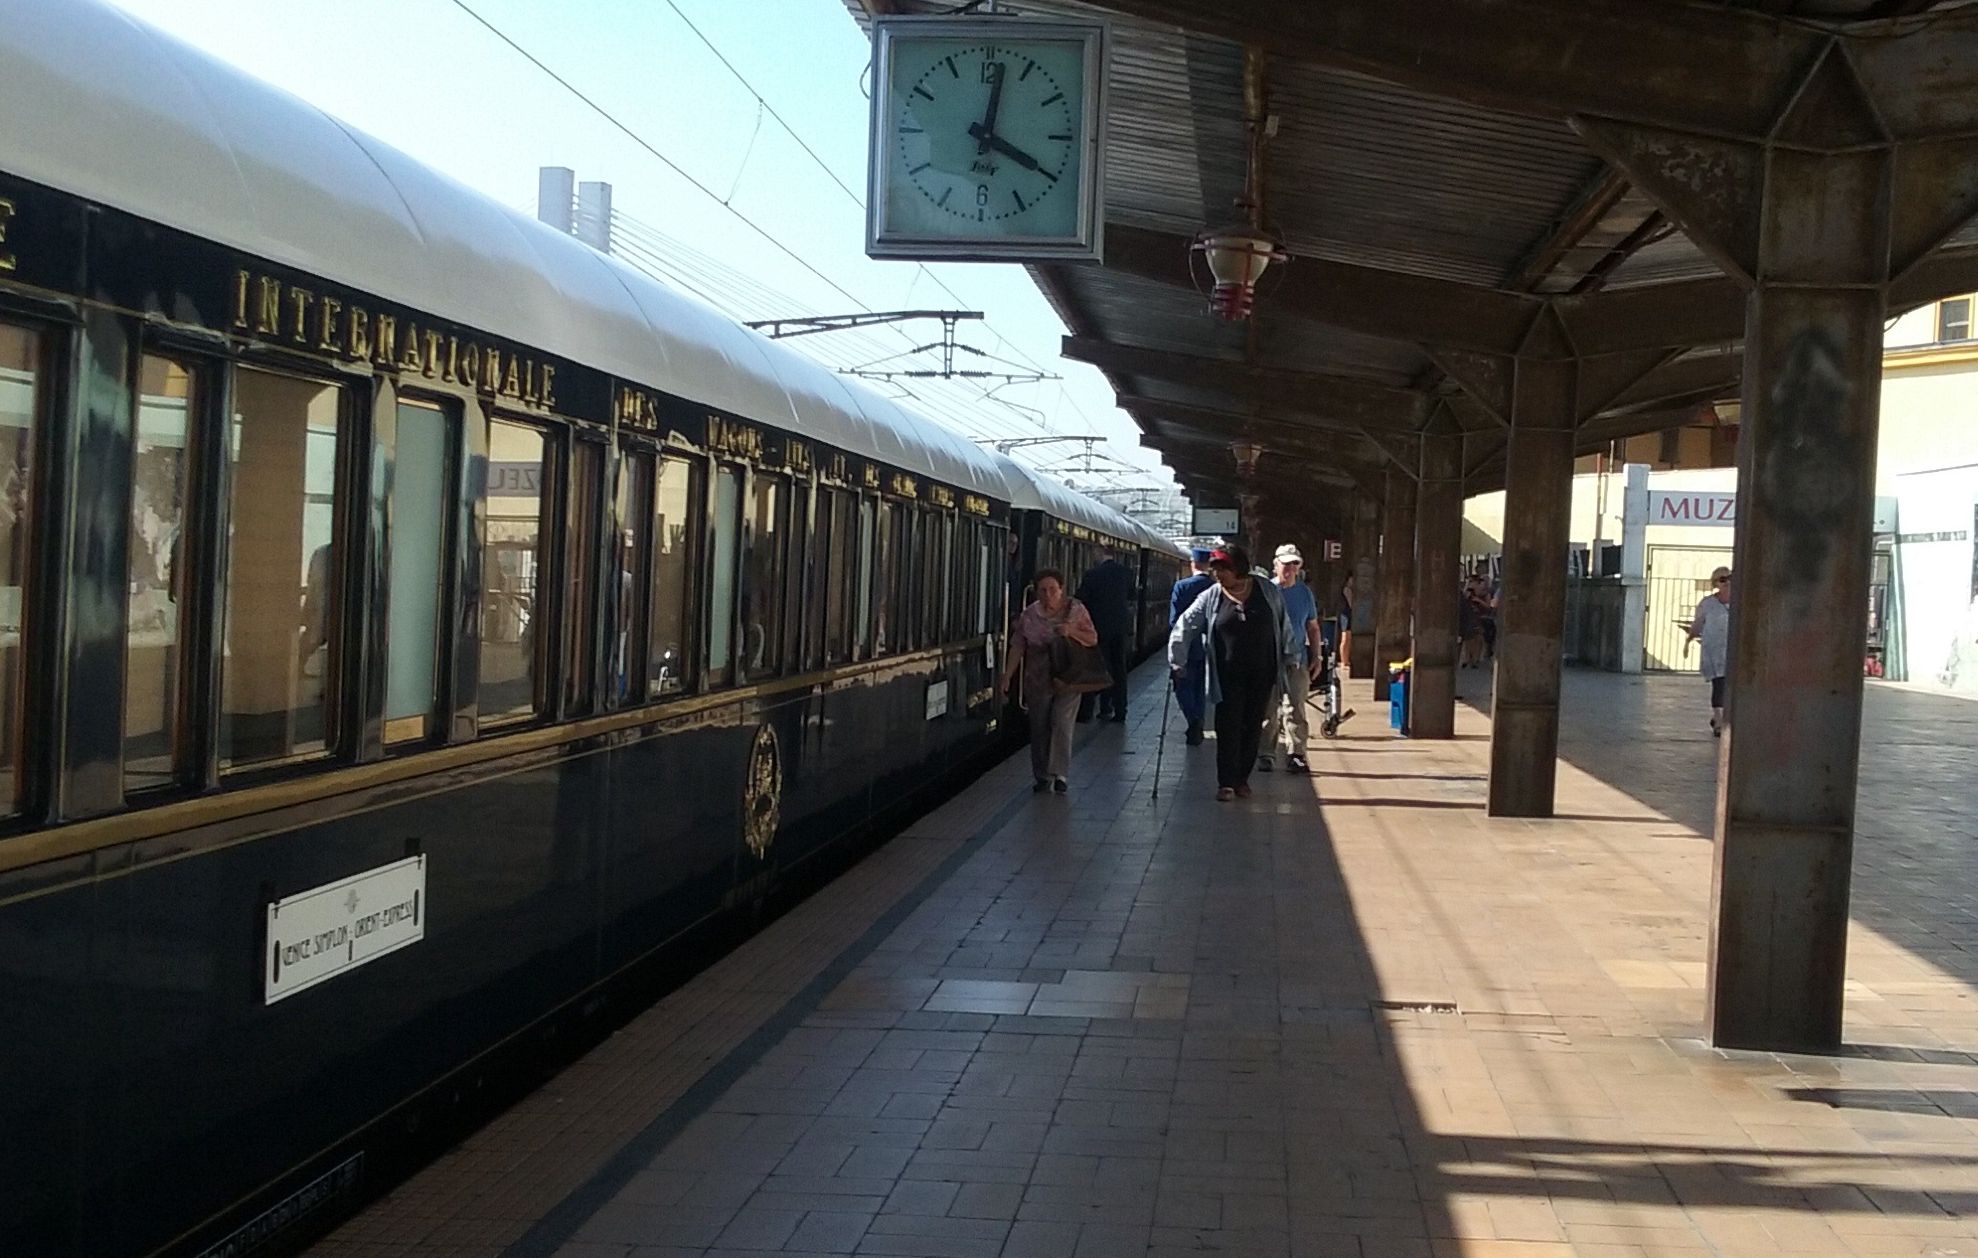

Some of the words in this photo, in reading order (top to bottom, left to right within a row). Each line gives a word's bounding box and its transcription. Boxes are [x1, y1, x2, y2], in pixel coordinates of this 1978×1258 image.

[980, 62, 999, 84] 12
[976, 184, 989, 206] 6
[234, 270, 556, 406] INTERNATIONALE
[1660, 497, 1735, 521] MUZ
[1330, 542, 1342, 559] E
[283, 939, 310, 966] VENICE
[314, 925, 348, 955] SIMPLON
